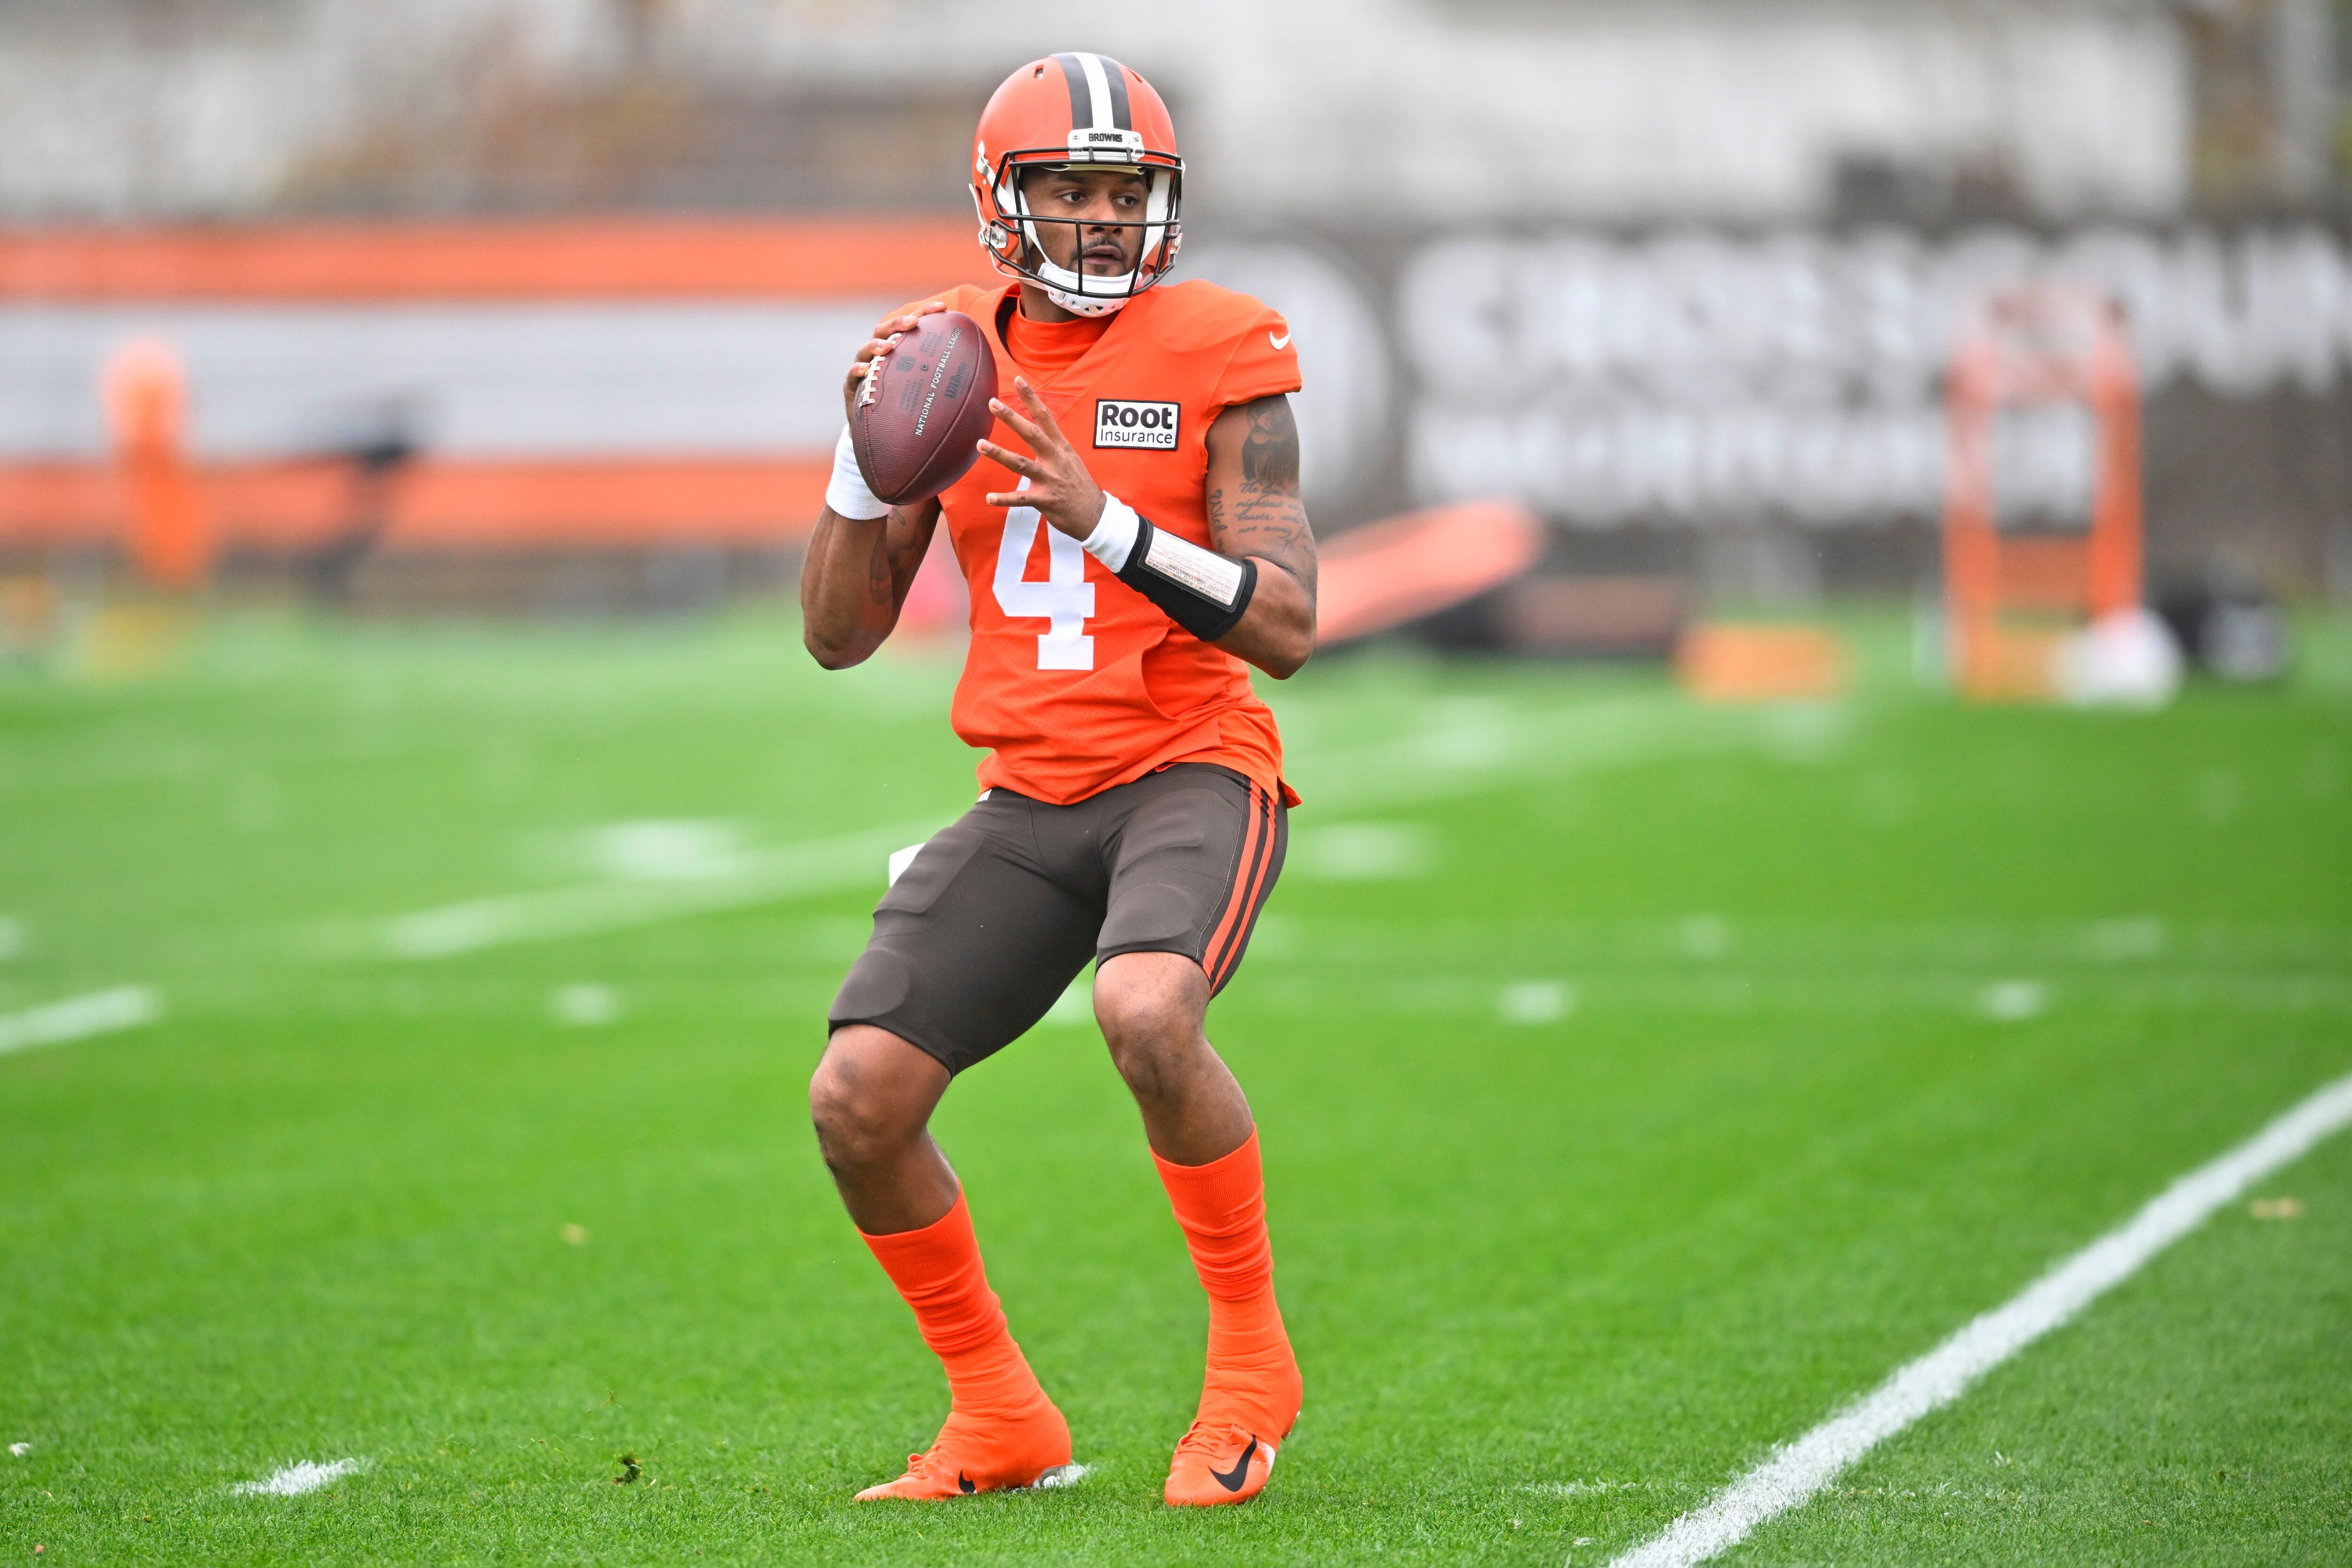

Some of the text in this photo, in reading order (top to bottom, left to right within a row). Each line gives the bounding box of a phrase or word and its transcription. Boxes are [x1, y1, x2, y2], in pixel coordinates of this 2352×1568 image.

[1089, 133, 1123, 143] BROWNS
[915, 328, 961, 436] NATIONAL FOOTBALL LEAGUE
[1102, 404, 1173, 430] Root
[1101, 429, 1172, 444] Insurance
[993, 475, 1095, 670] 4
